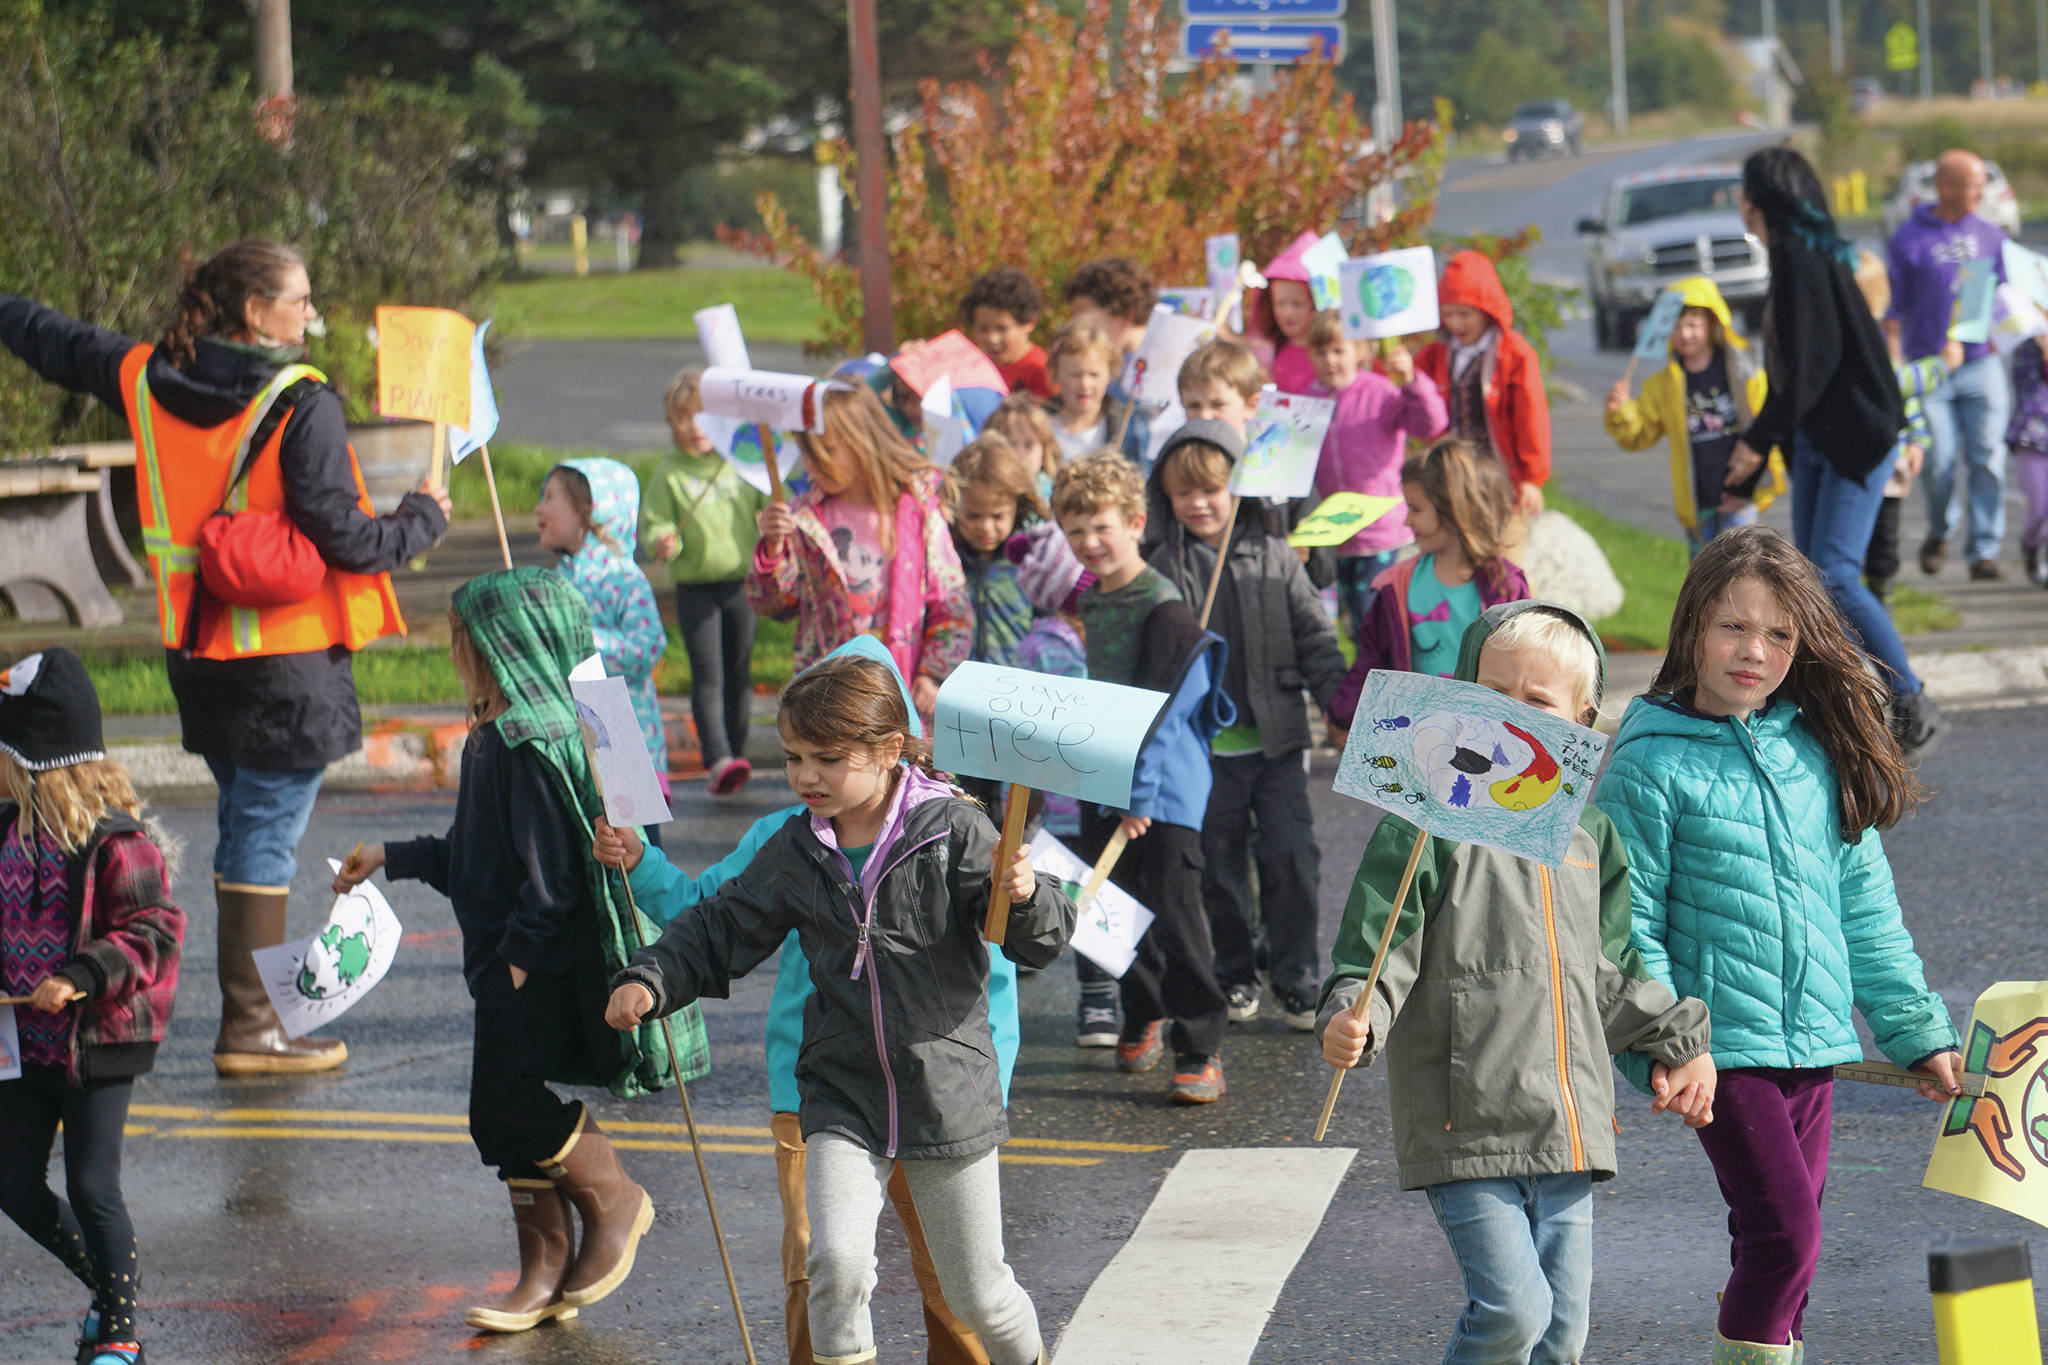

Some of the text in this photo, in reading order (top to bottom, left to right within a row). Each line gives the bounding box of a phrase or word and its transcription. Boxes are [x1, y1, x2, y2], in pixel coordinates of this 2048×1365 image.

[729, 379, 788, 403] Trees
[988, 696, 1067, 721] our
[945, 711, 1100, 774] tree
[1561, 756, 1596, 781] BEES
